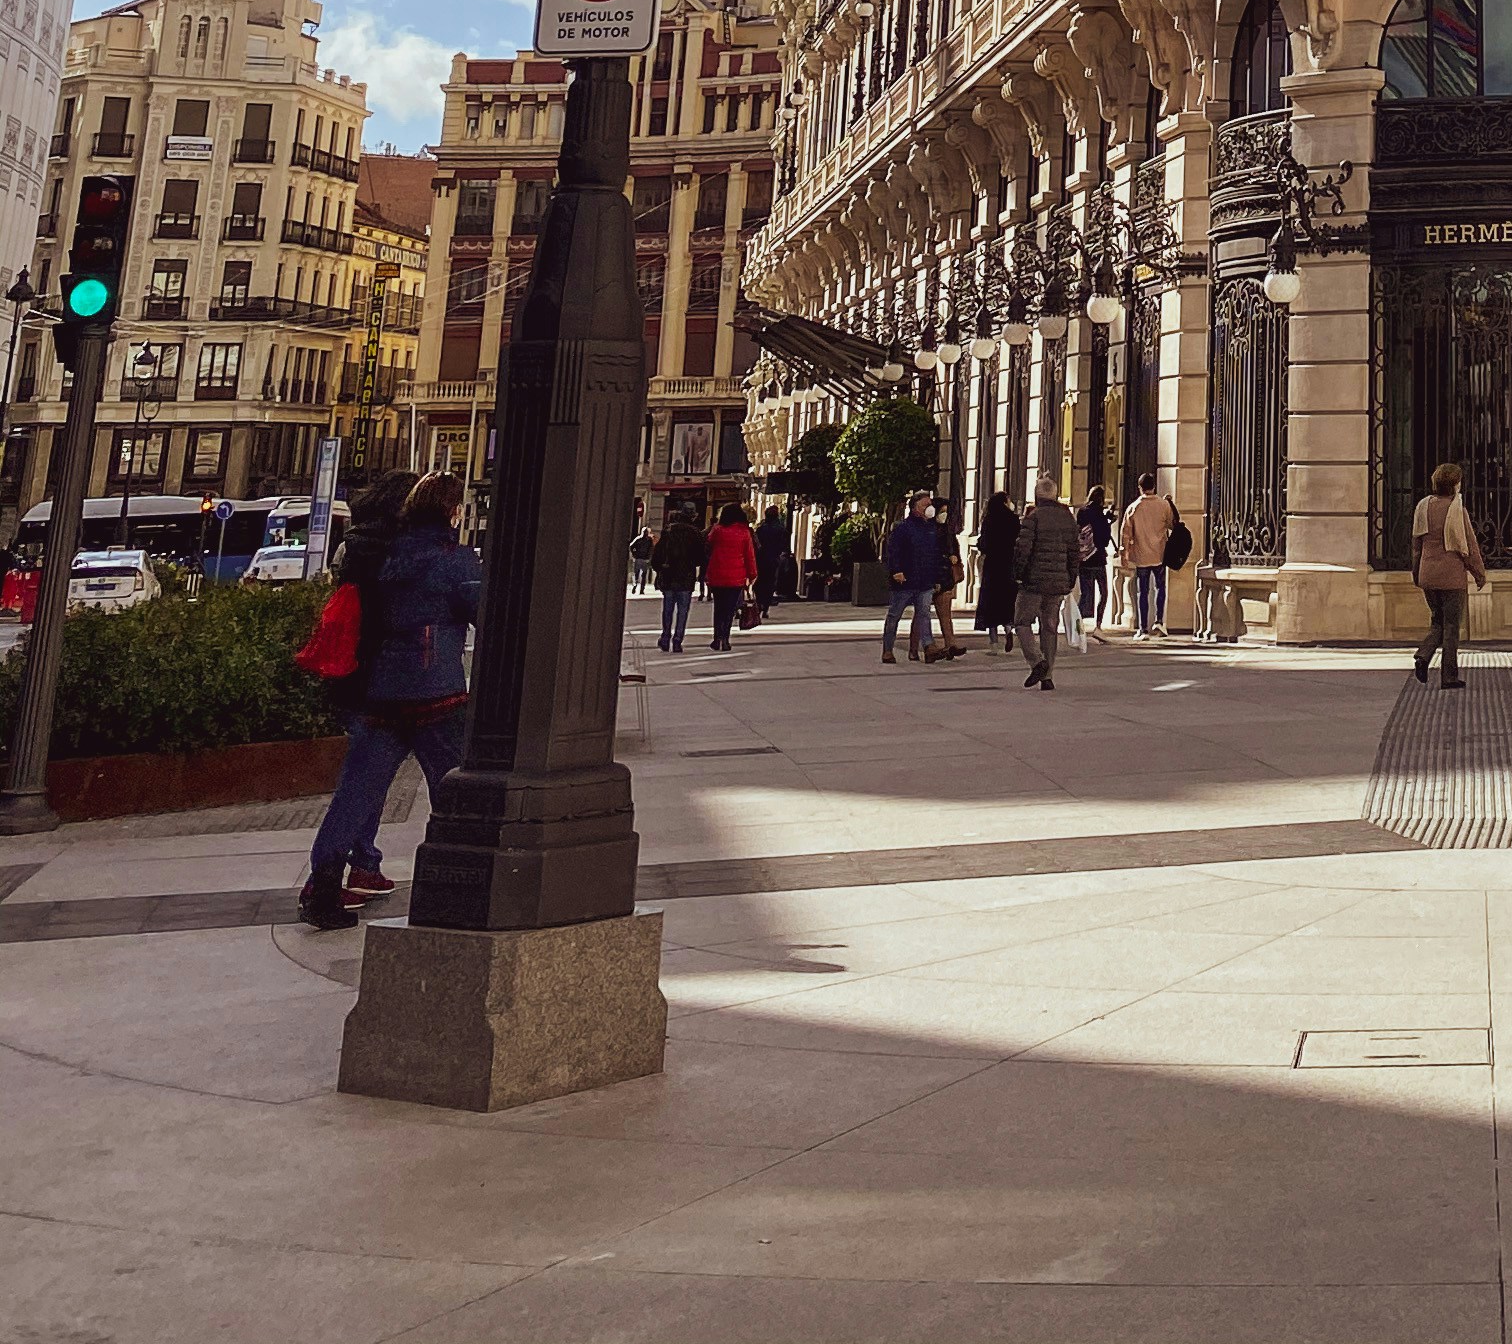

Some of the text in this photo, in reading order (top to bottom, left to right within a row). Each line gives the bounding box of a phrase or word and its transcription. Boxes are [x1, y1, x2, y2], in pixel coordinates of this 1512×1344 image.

[557, 7, 634, 23] VEHÍCULOS
[557, 26, 630, 39] DE MOTOR
